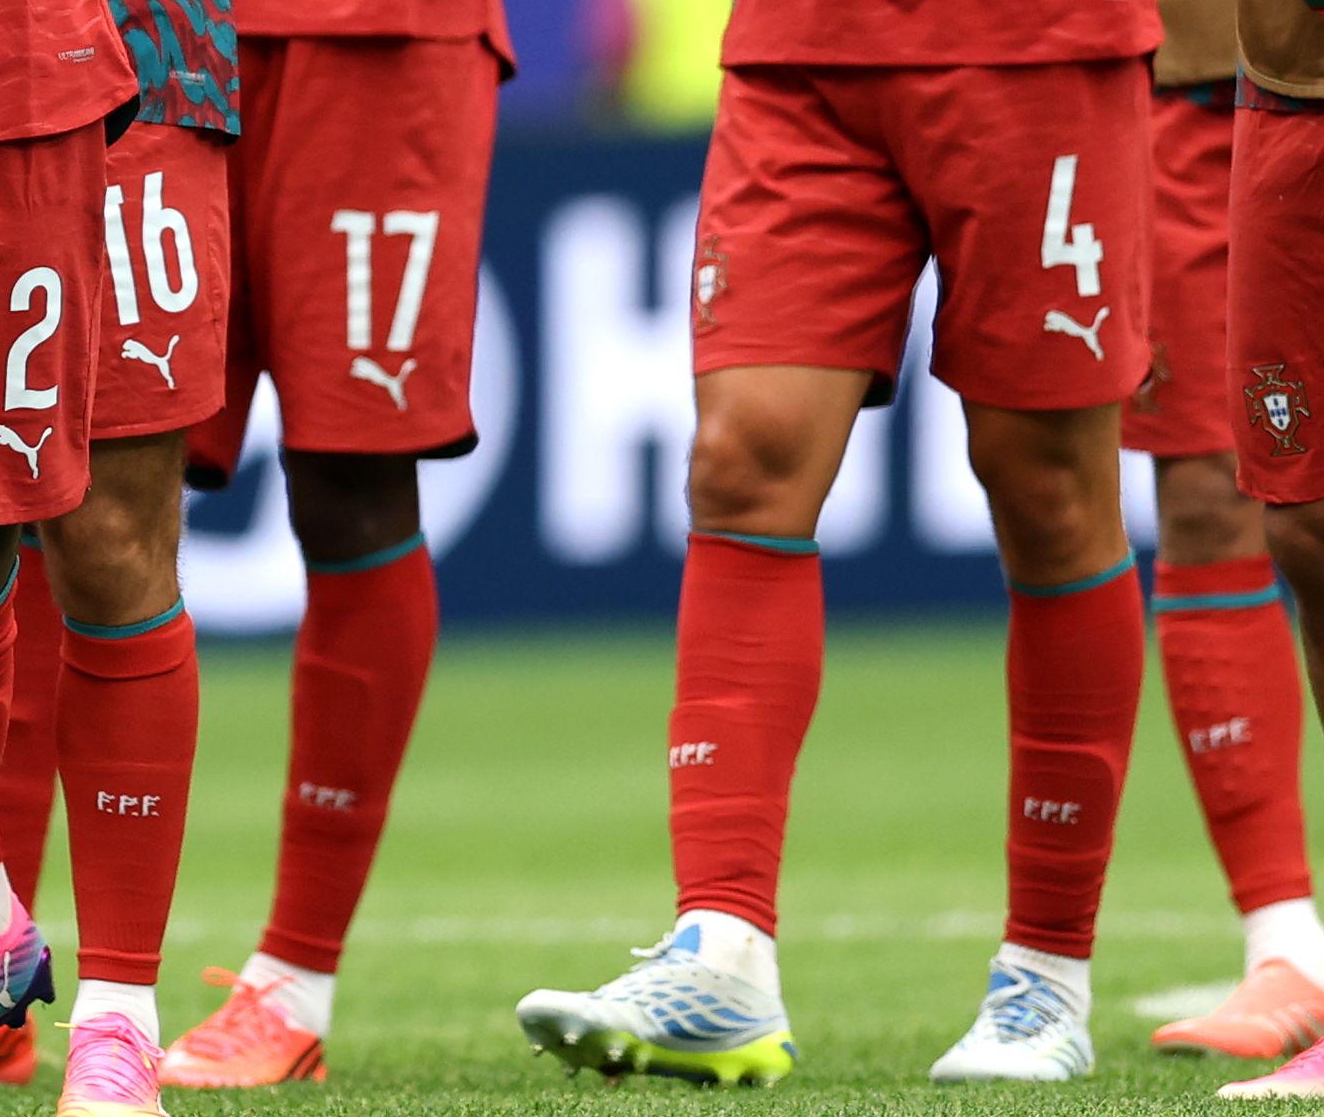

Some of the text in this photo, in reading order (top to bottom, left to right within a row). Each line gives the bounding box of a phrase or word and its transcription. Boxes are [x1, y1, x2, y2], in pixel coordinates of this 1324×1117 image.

[103, 170, 199, 326] 16
[331, 210, 440, 352] 17
[1040, 154, 1104, 297] 4
[3, 266, 63, 412] 2
[97, 790, 162, 817] F.P.F.
